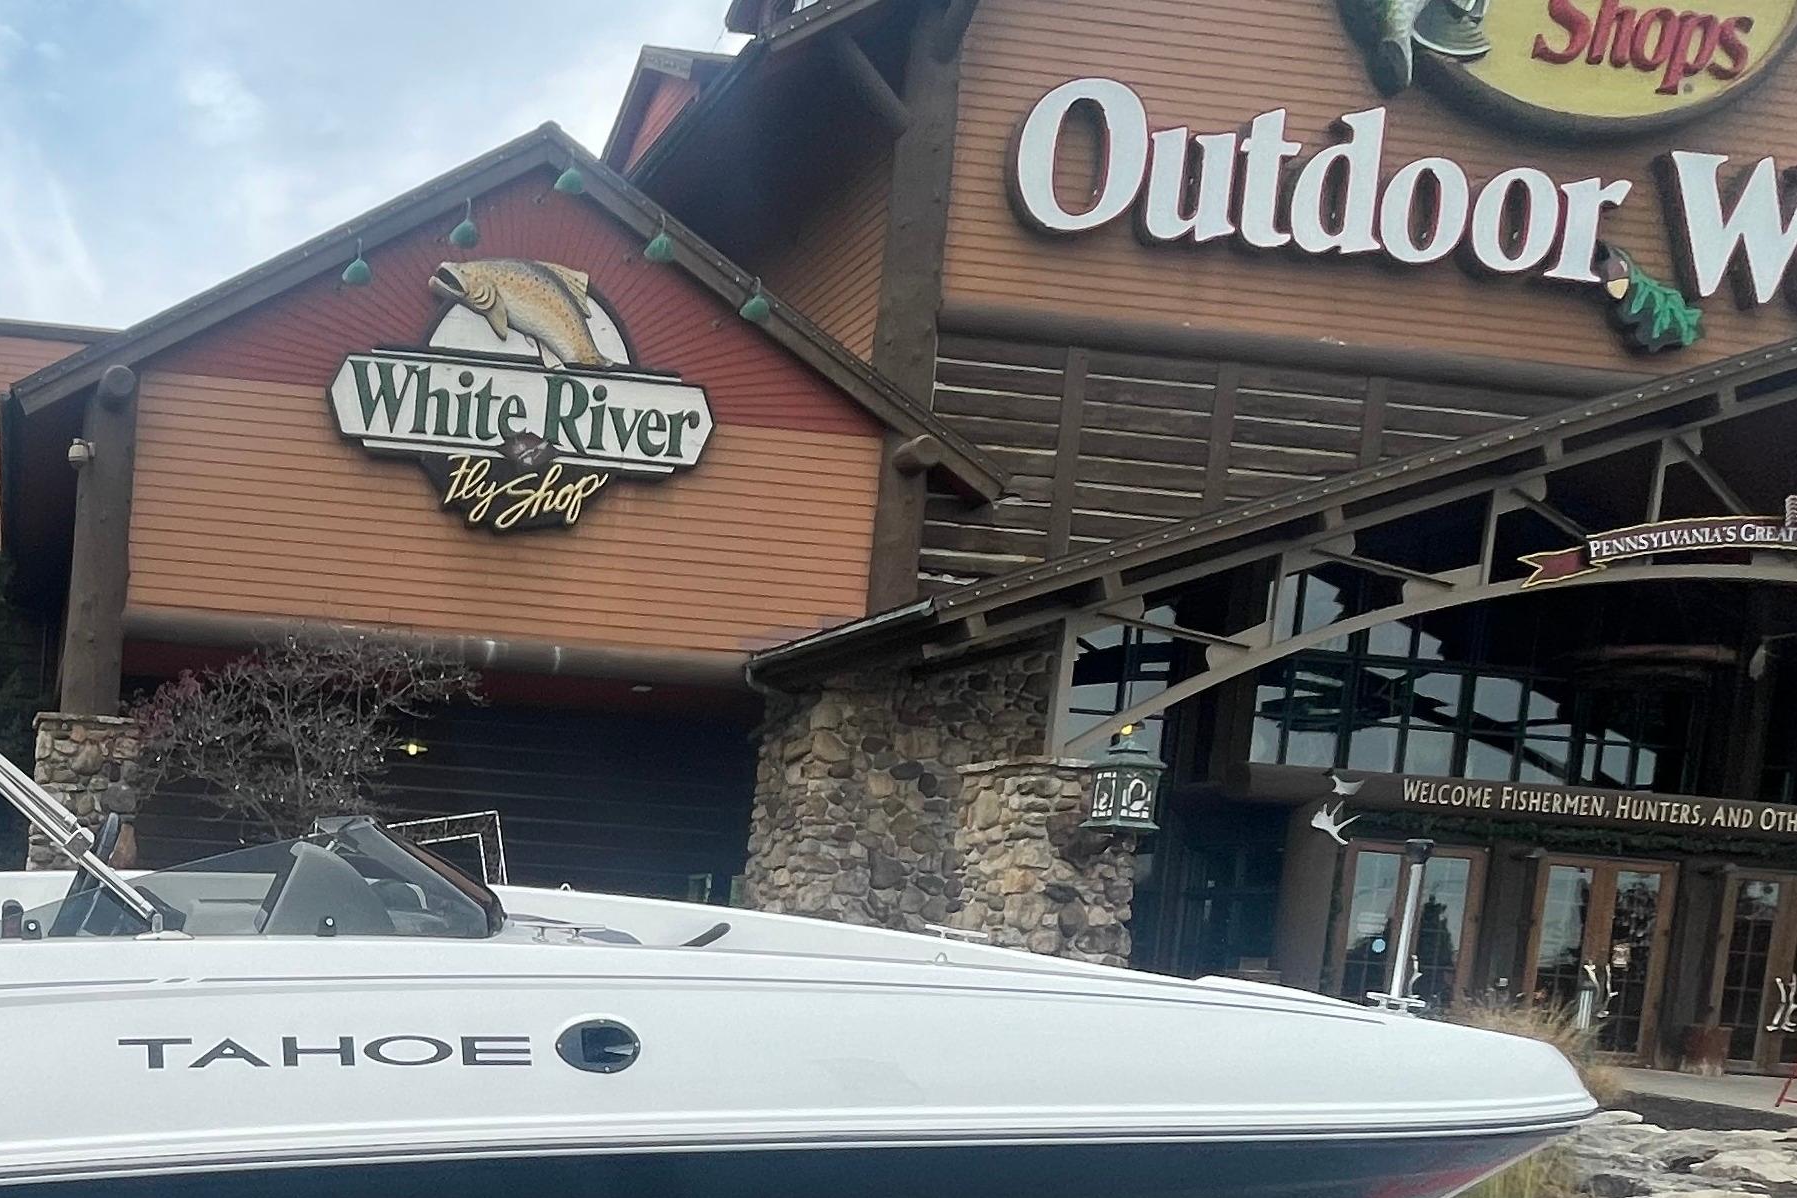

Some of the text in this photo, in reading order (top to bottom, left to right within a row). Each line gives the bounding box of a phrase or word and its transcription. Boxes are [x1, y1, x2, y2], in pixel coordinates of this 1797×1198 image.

[1531, 0, 1754, 95] Shops
[1017, 77, 1633, 284] Outdoor
[349, 359, 700, 459] White River
[444, 454, 609, 530] Fly Shop
[1588, 525, 1737, 558] PENNSYLVANIA'S
[1403, 777, 1493, 810] WELCOME
[1501, 786, 1610, 819] FISHERMEN,
[1614, 795, 1707, 827] HUNTERS,
[1711, 805, 1754, 829] AND
[118, 1035, 532, 1069] TAHOE
